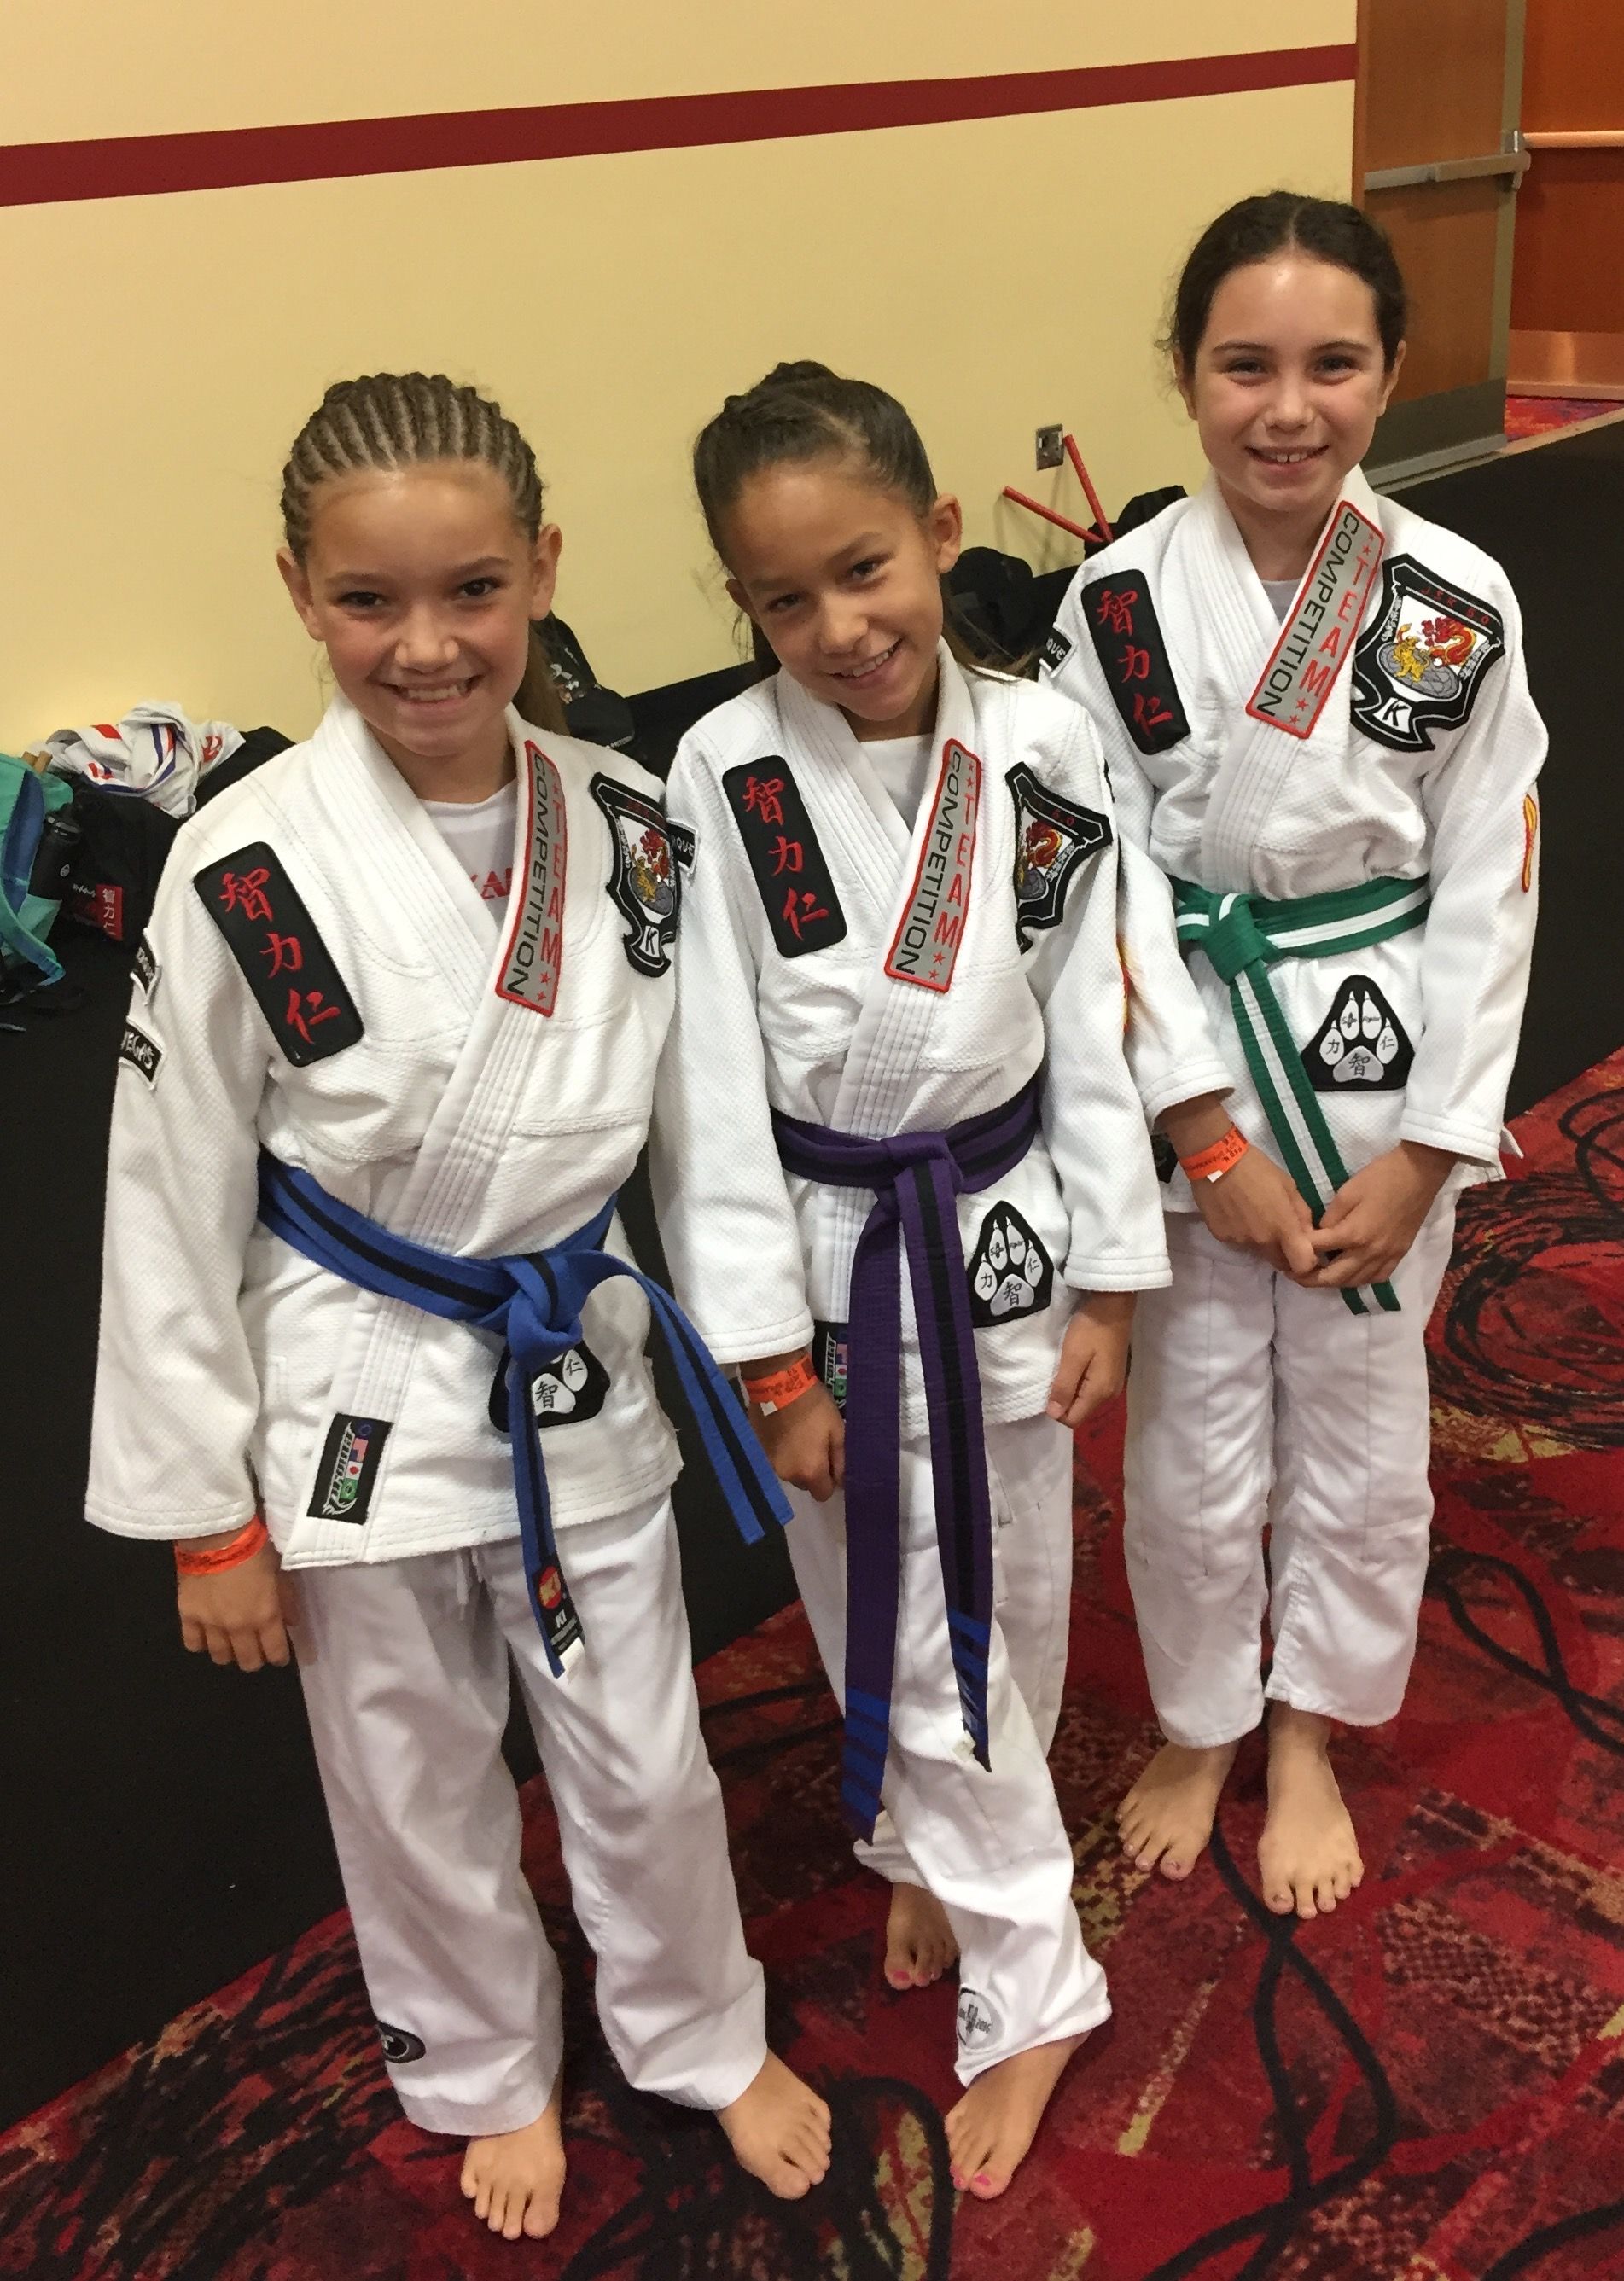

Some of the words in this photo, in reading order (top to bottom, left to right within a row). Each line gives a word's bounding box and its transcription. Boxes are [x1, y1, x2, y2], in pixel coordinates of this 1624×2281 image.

[1097, 589, 1173, 736] 智力仁
[1257, 511, 1360, 717] COMPETITION
[1299, 556, 1371, 698] TEAM
[505, 753, 545, 996] COMPETITION
[539, 797, 565, 967] TEAM
[742, 776, 829, 940] 智力仁
[895, 749, 962, 975] COMPETITION
[934, 793, 975, 948] TEAM
[218, 867, 341, 1044] 智力仁
[534, 1381, 559, 1409] 智
